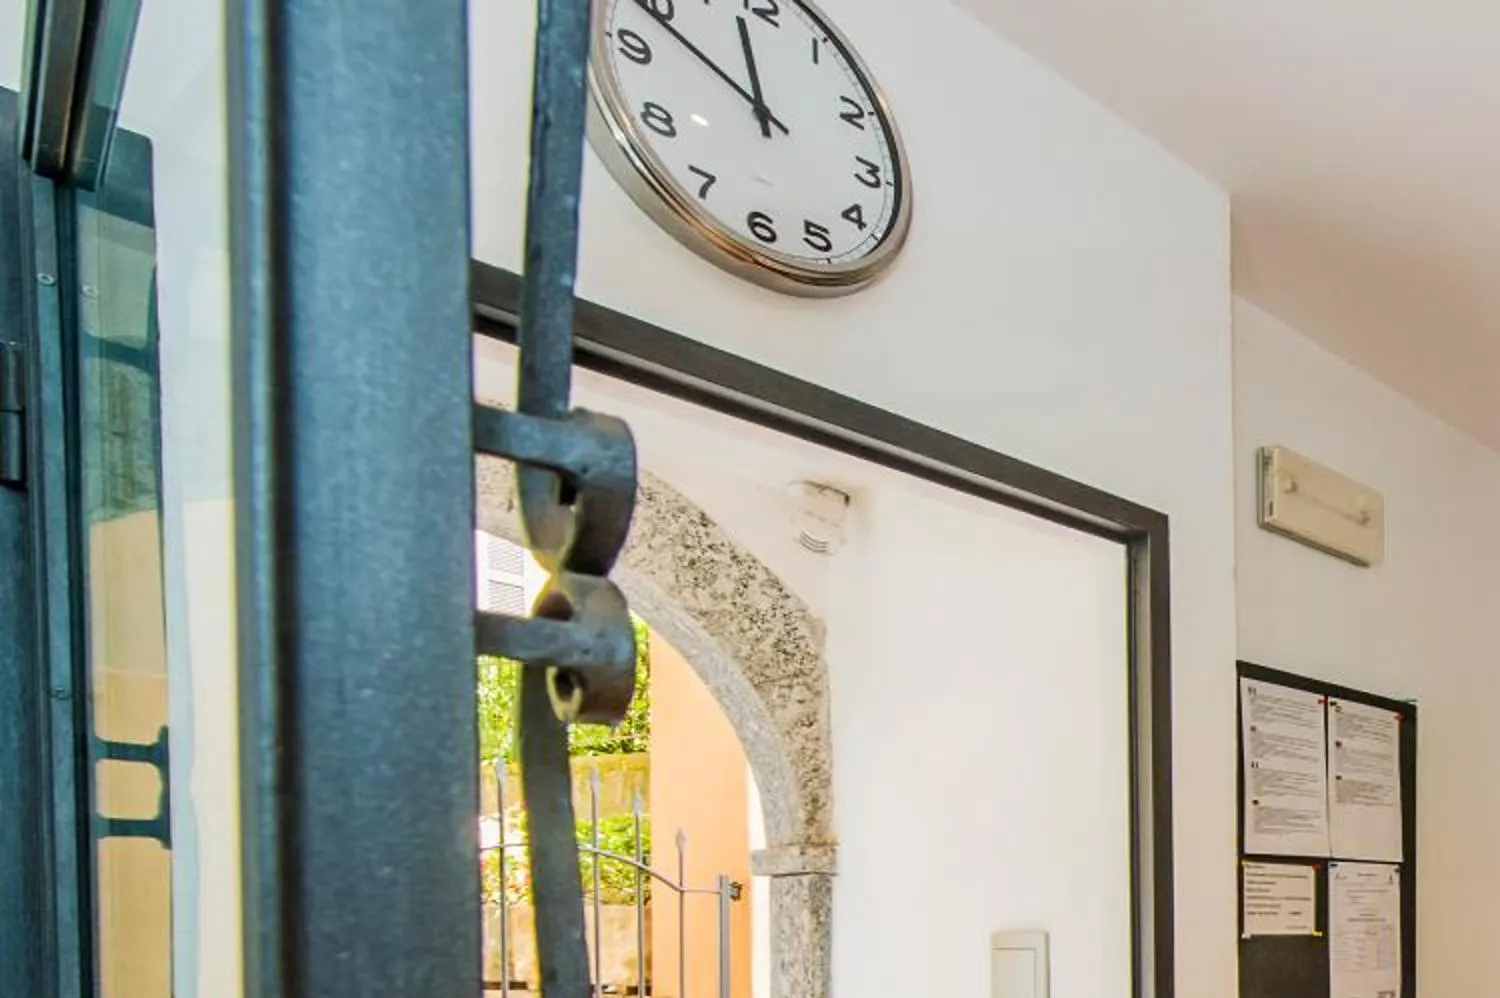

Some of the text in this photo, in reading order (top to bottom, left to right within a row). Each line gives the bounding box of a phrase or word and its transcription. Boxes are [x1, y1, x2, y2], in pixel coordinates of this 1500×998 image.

[617, 28, 652, 65] 9
[812, 37, 819, 65] 1
[640, 101, 677, 138] 8
[839, 95, 866, 131] 2
[688, 164, 717, 199] 7
[854, 155, 881, 189] 3
[747, 211, 777, 243] 6
[841, 203, 867, 231] 4
[802, 219, 833, 252] 5
